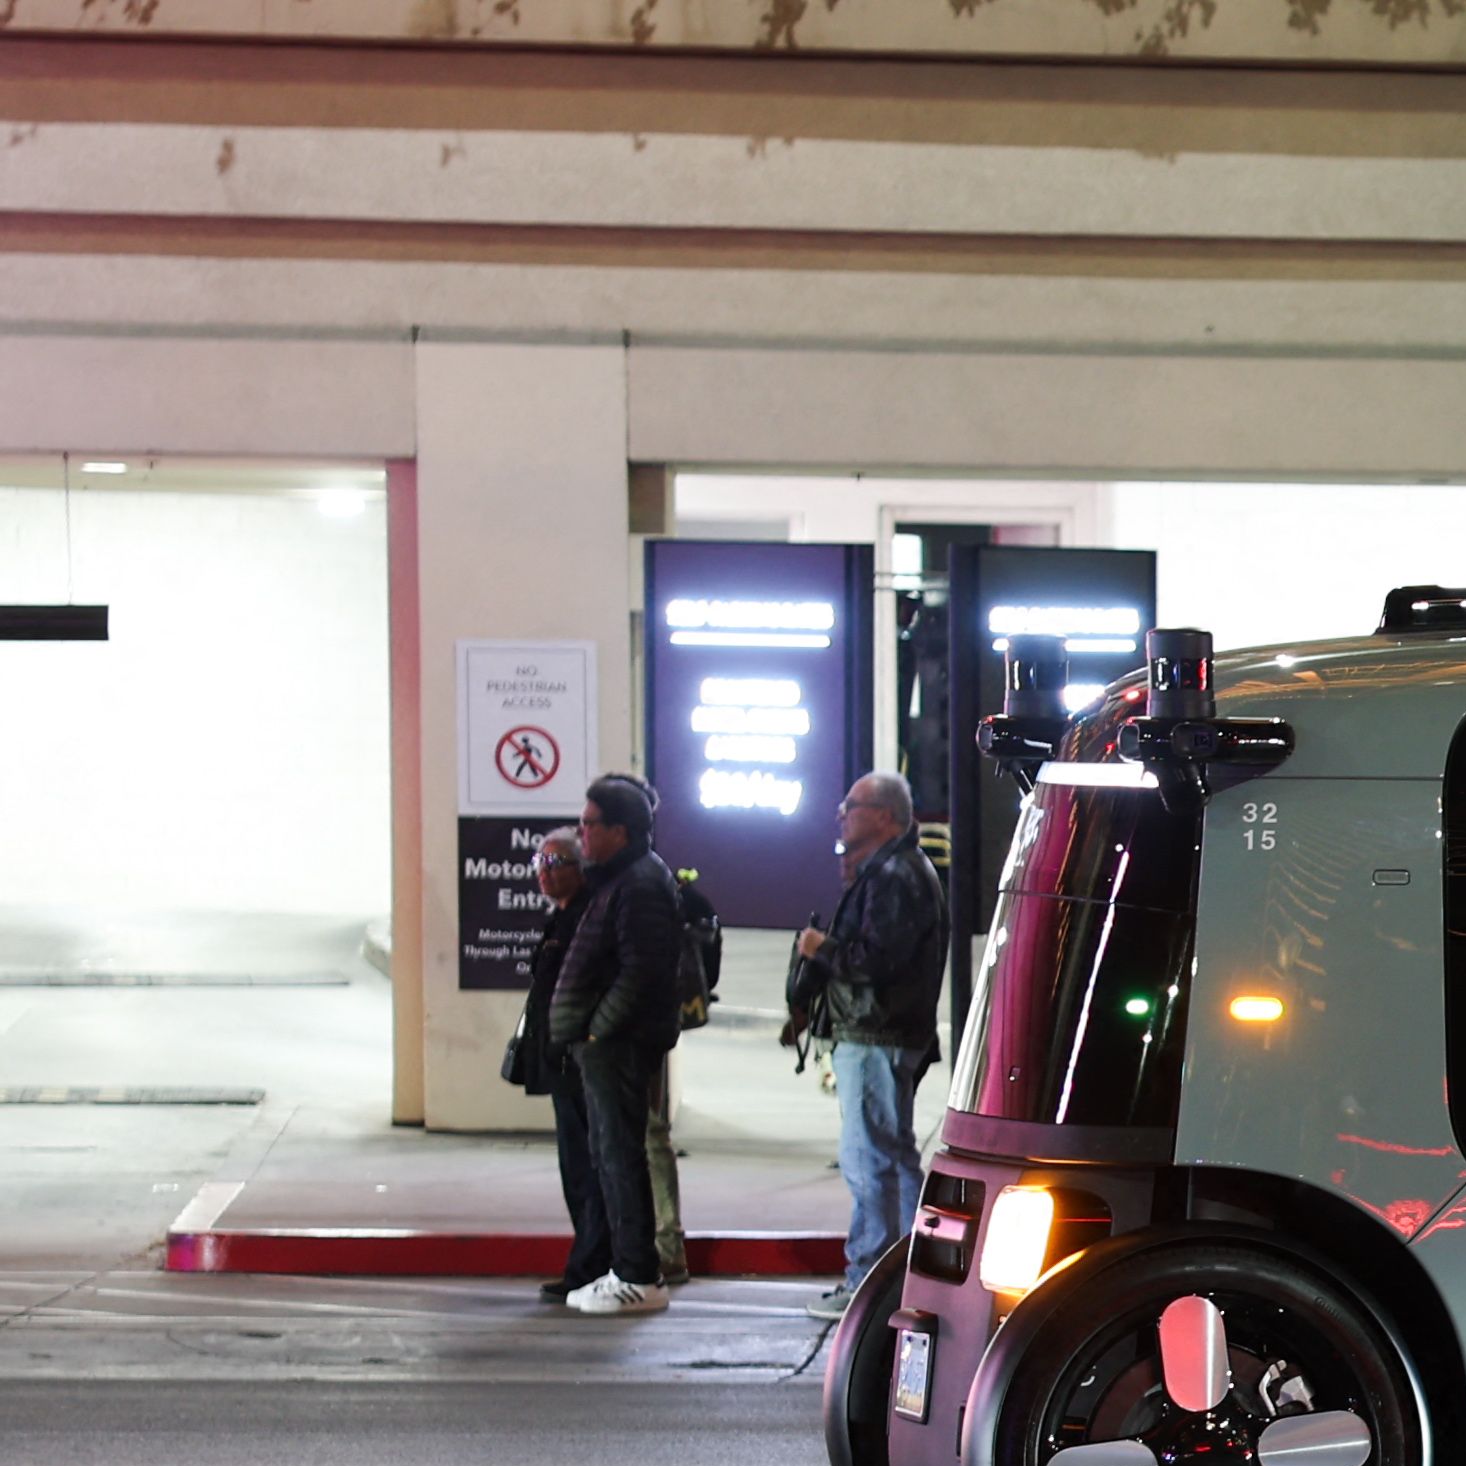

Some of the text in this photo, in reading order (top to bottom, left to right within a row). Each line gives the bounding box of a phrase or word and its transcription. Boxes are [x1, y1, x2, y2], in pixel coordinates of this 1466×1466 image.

[515, 664, 538, 676] NO
[486, 680, 567, 692] PEDESTRIAN
[502, 697, 551, 709] ACCESS
[1242, 803, 1278, 823] 32
[511, 828, 545, 850] No
[1243, 829, 1276, 850] 15
[465, 857, 536, 879] Motor
